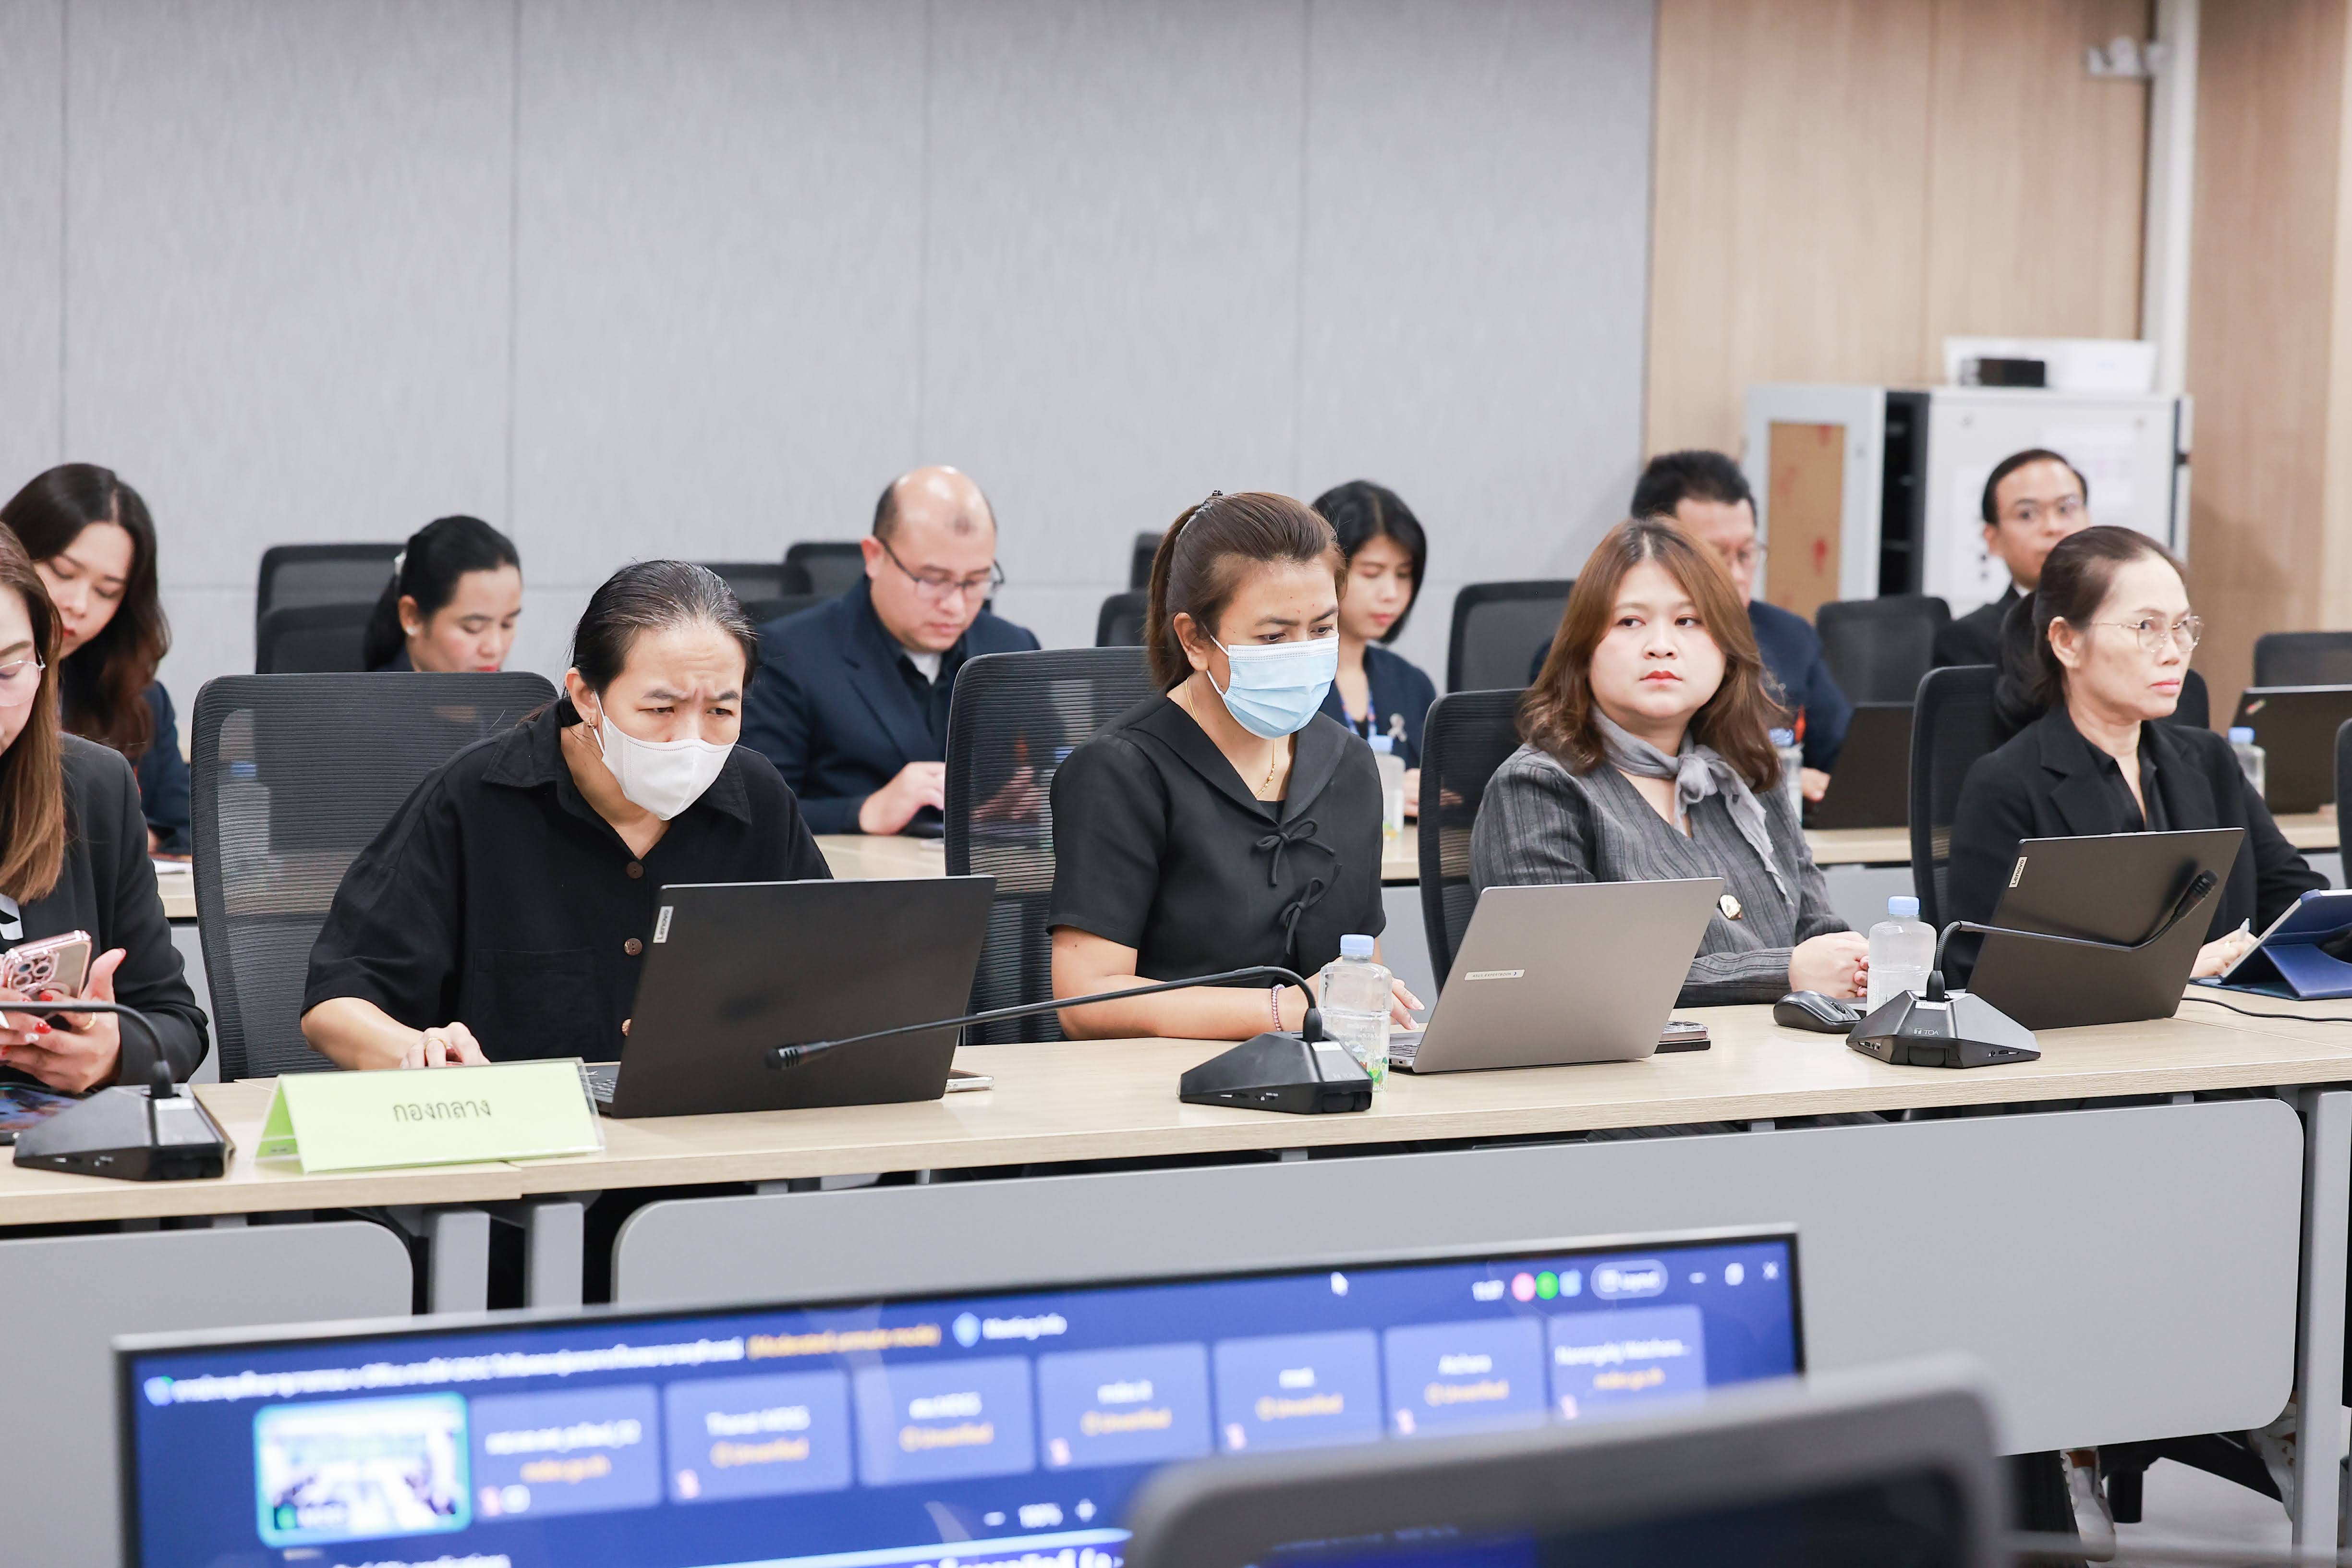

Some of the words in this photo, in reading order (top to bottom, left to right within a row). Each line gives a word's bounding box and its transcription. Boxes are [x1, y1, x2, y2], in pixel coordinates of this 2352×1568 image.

[2011, 860, 2024, 885] Lenovo
[393, 1099, 492, 1122] กองกลาง
